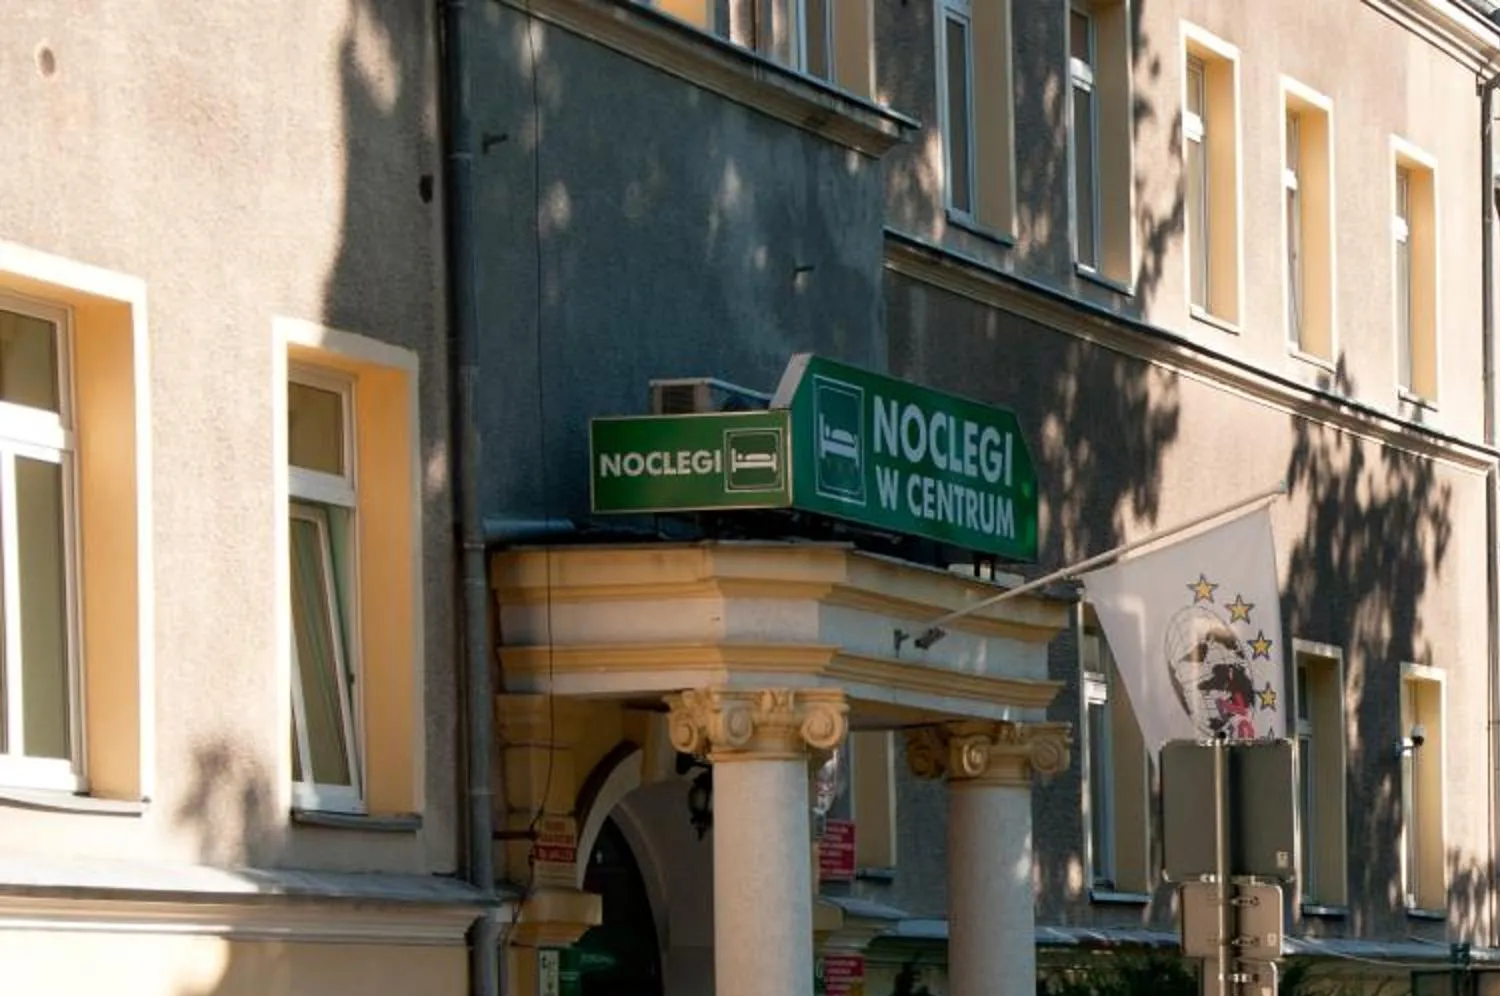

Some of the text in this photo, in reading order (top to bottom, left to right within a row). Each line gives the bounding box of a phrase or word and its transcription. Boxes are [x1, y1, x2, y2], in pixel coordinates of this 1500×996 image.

[599, 449, 722, 477] NOCLEGI
[873, 396, 1014, 487] NOCLEGI
[876, 464, 1015, 540] W CENTRUM
